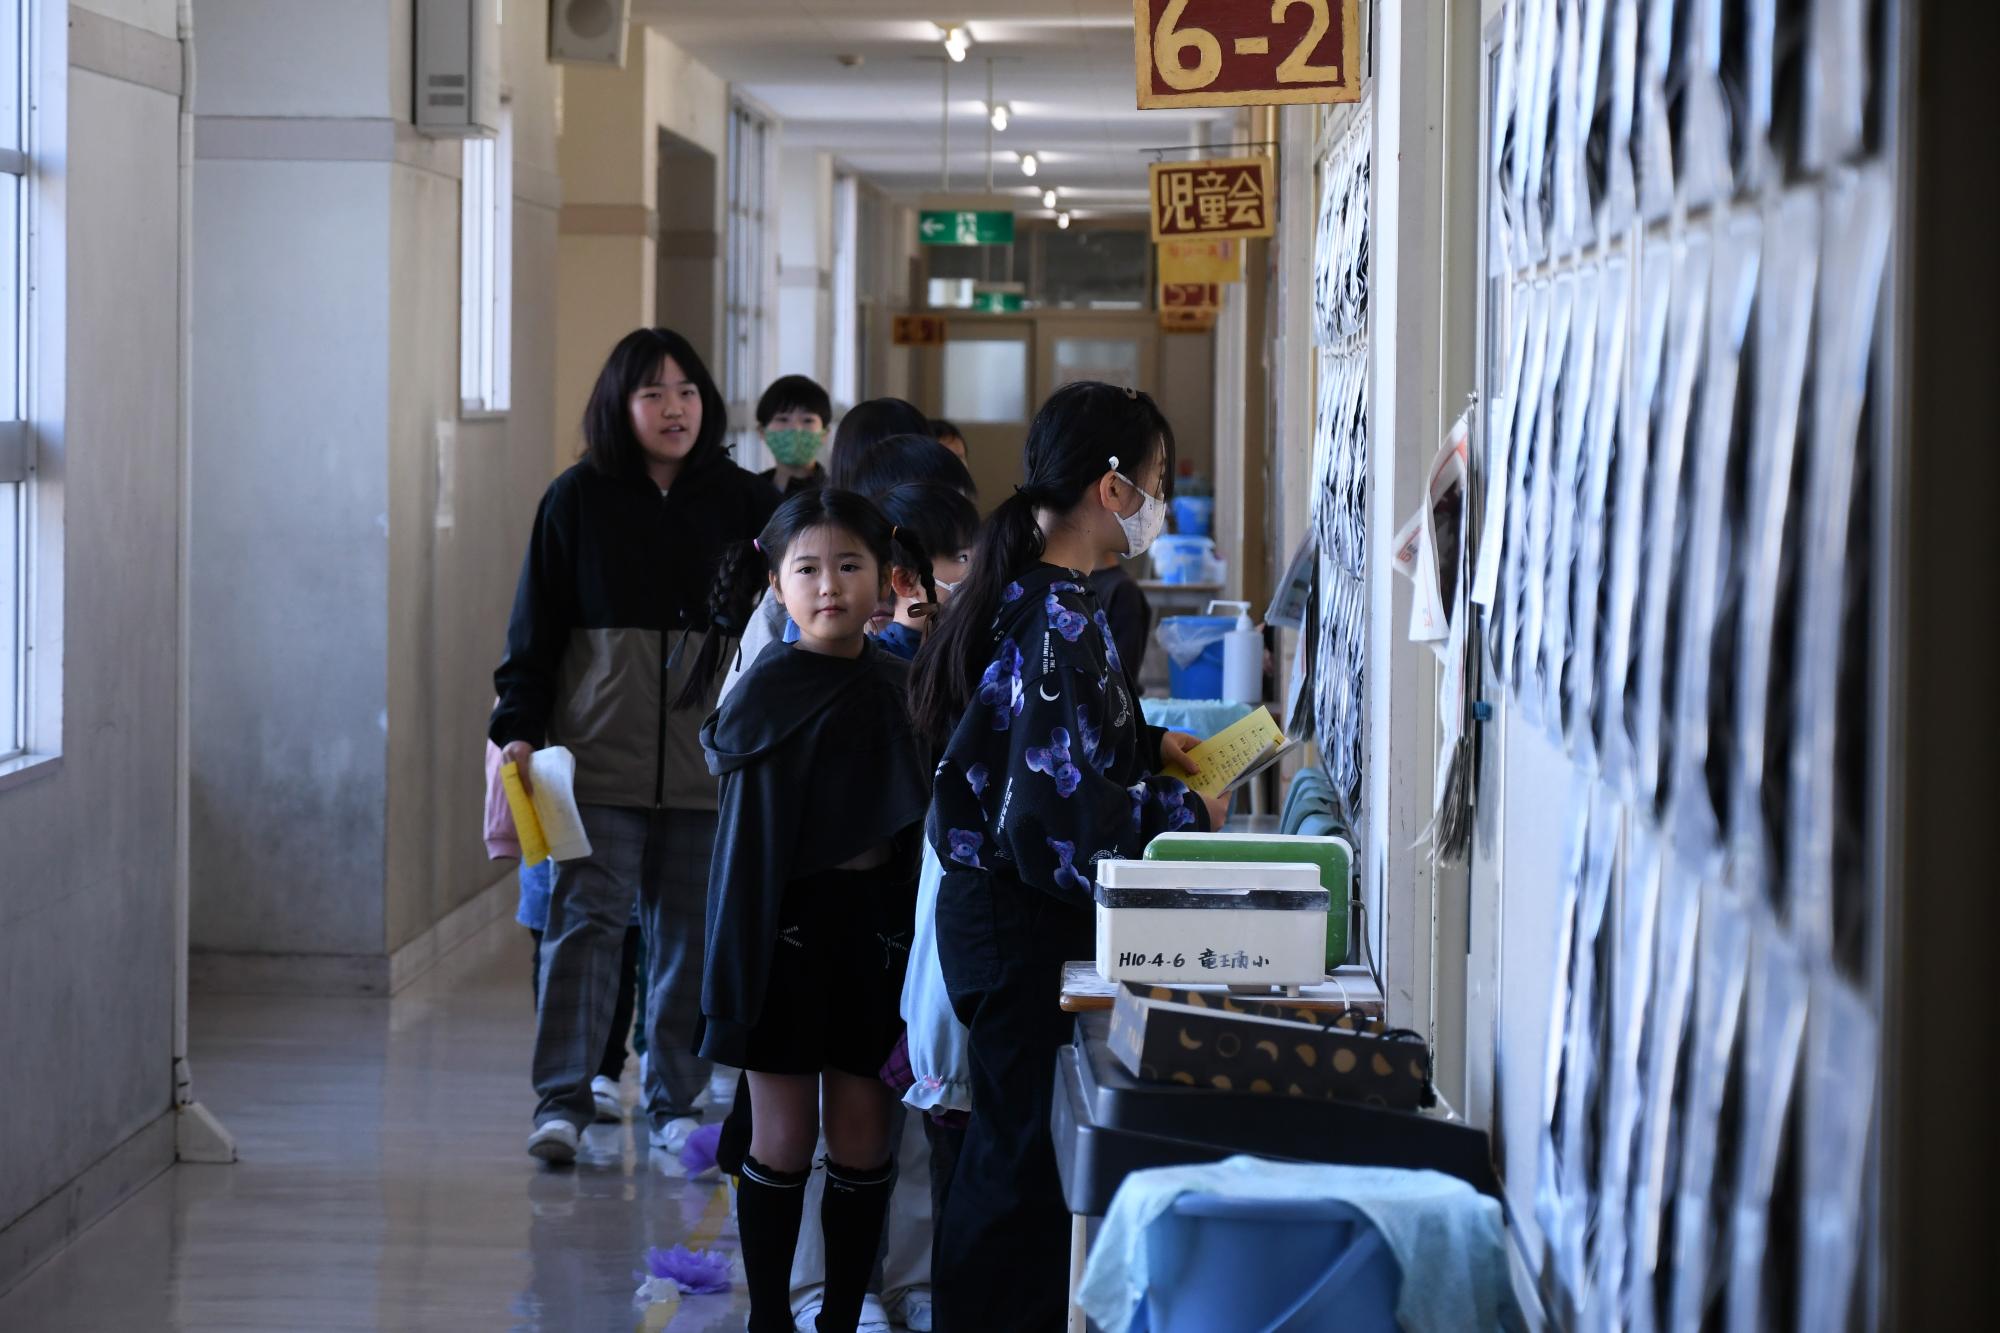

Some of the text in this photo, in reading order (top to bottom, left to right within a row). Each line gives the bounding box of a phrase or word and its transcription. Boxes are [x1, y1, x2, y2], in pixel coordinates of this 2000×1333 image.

[1154, 0, 1338, 90] 6-2
[1160, 171, 1262, 230] 児童会
